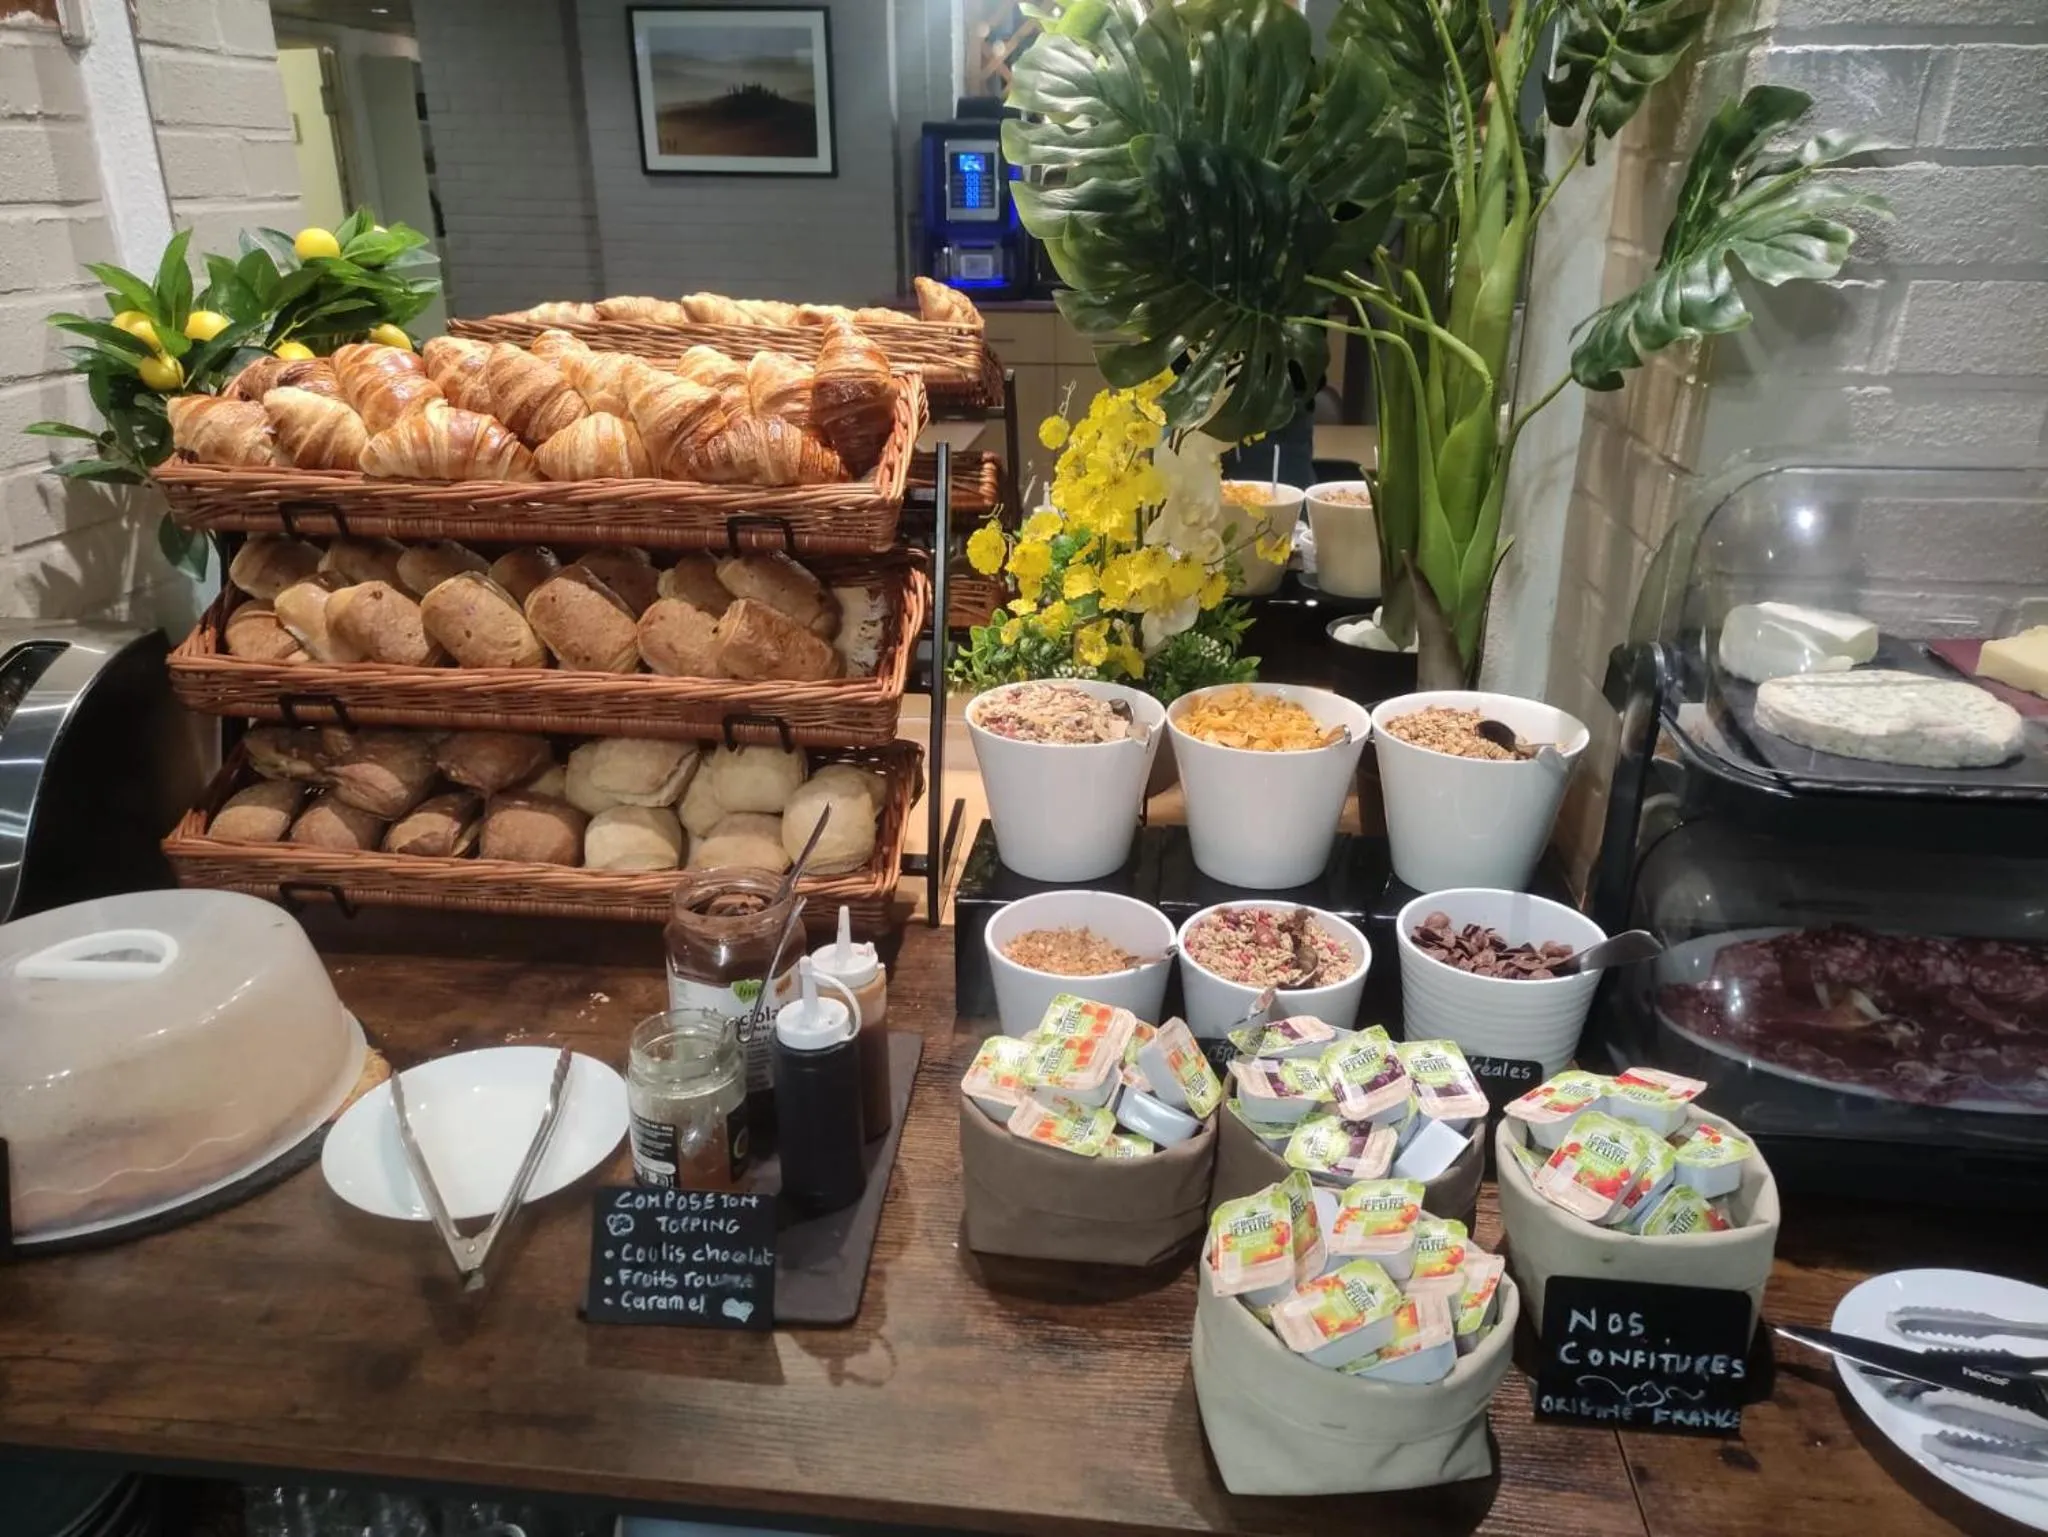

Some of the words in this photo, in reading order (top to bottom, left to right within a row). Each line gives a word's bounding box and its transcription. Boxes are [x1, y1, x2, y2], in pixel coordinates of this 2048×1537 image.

[614, 1190, 716, 1212] COMPOSE
[621, 1242, 686, 1264] Coulis
[618, 1269, 678, 1289] Fruits
[620, 1290, 706, 1313] Caramel
[1567, 1306, 1646, 1337] NOS
[1558, 1341, 1746, 1380] CONFITURES
